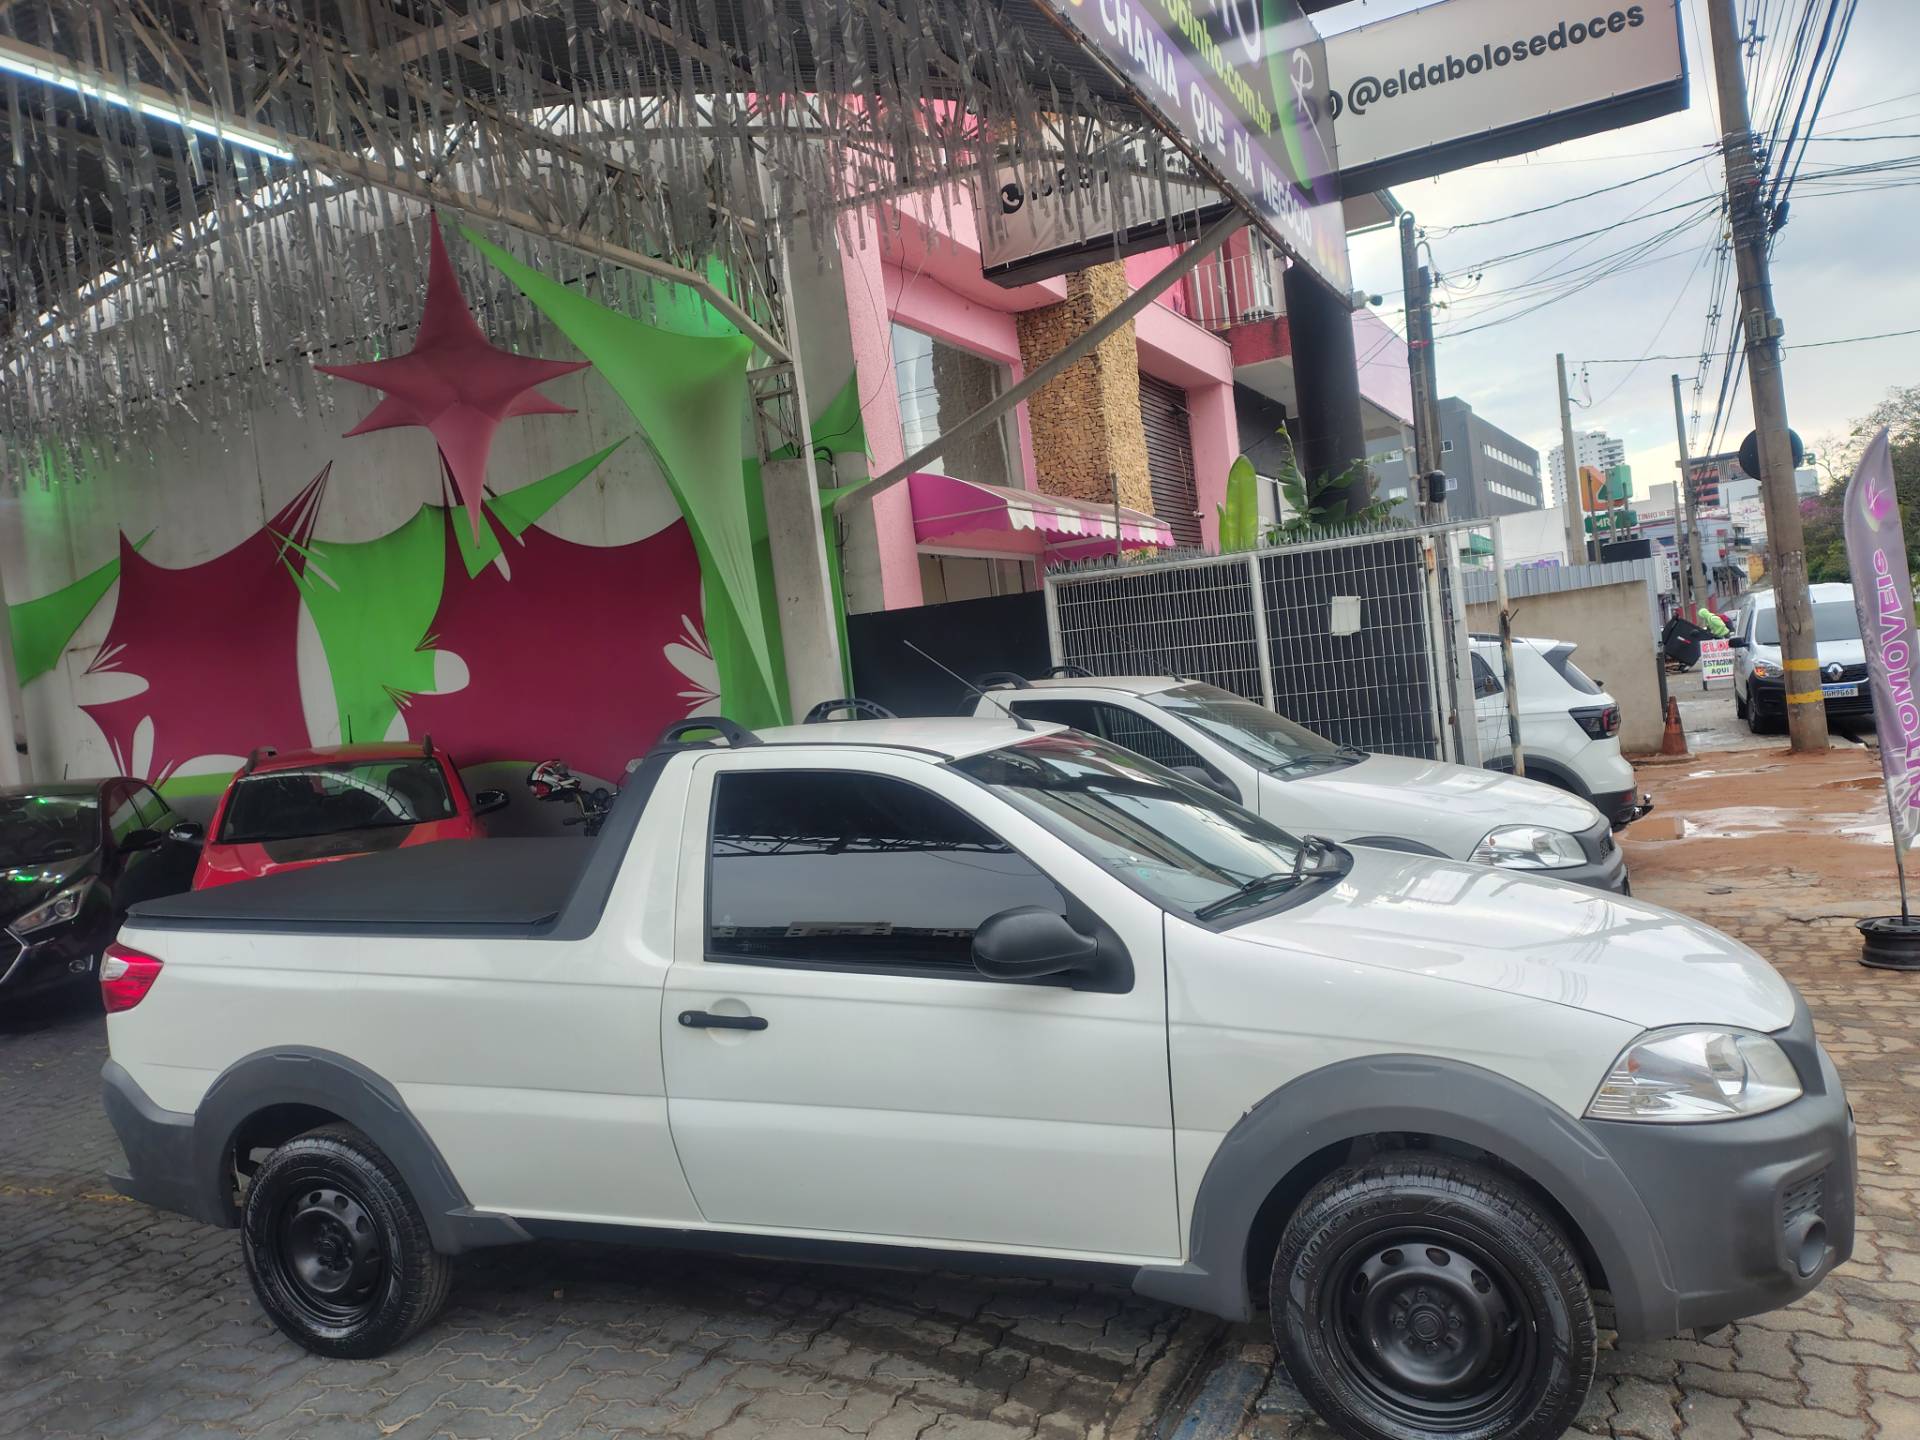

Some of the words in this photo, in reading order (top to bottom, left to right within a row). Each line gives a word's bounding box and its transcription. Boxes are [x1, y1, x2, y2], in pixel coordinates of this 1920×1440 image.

[1100, 0, 1181, 108] CHAMA
[1190, 81, 1226, 157] QUE
[1233, 128, 1255, 188] DÁ
[1261, 162, 1312, 247] NEGÓCIO
[1160, 0, 1272, 138] obinho.com.br
[1347, 5, 1645, 115] @eldabolosedoces
